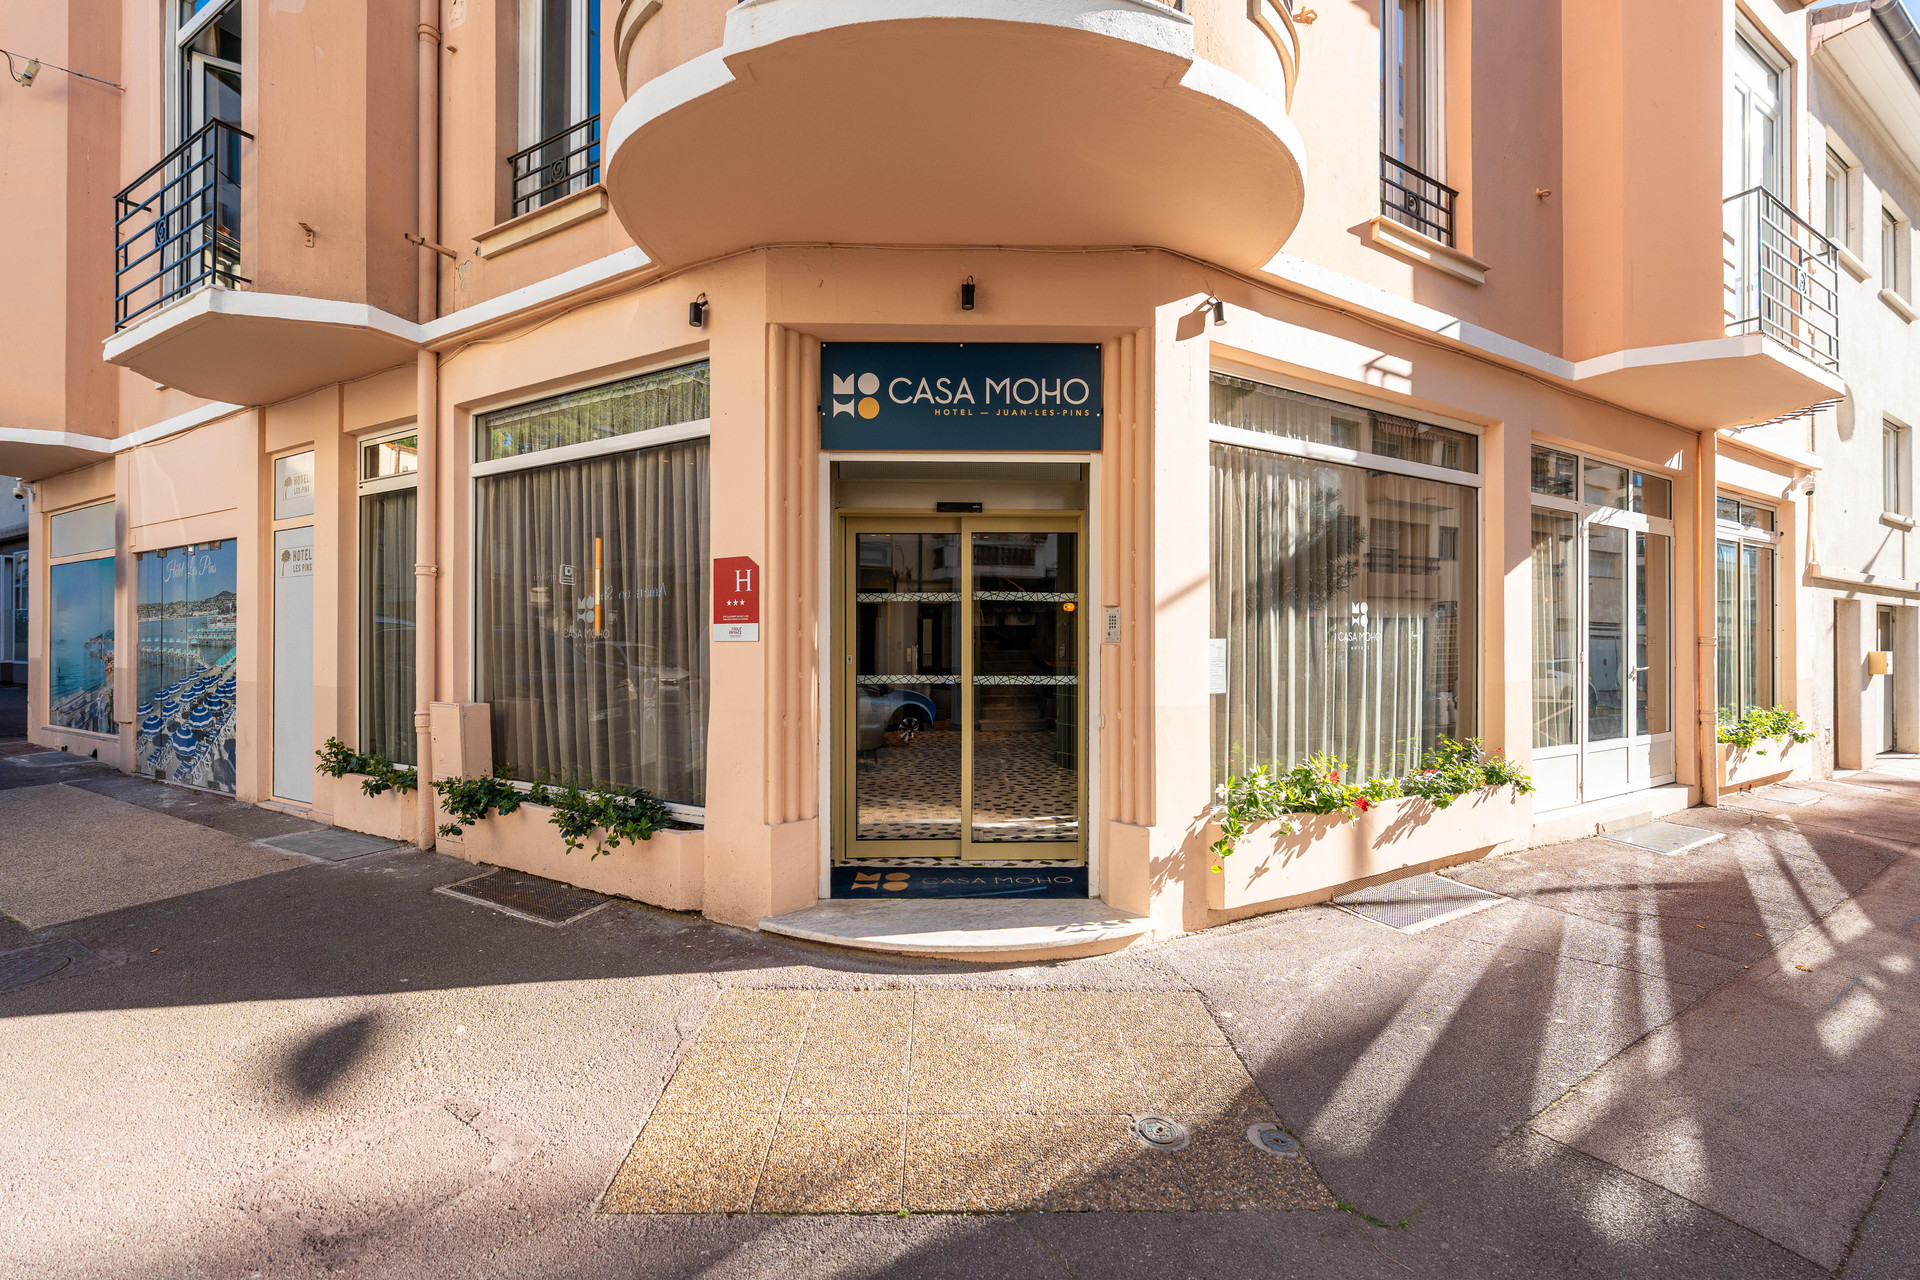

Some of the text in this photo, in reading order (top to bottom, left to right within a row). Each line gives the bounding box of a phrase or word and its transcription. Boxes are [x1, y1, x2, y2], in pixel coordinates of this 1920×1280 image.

[888, 377, 1090, 405] CASA MOHO
[934, 408, 974, 416] HOTEL
[996, 408, 1090, 417] JUAN-LES-PINS
[293, 473, 310, 486] HOTEL
[293, 485, 310, 495] LES PINS
[292, 548, 312, 562] HOTEL
[292, 563, 313, 573] LES PINS
[734, 568, 753, 592] H
[563, 628, 583, 639] CASA
[1337, 631, 1382, 642] CASA MOHO
[922, 875, 1073, 885] CASA MOHO
